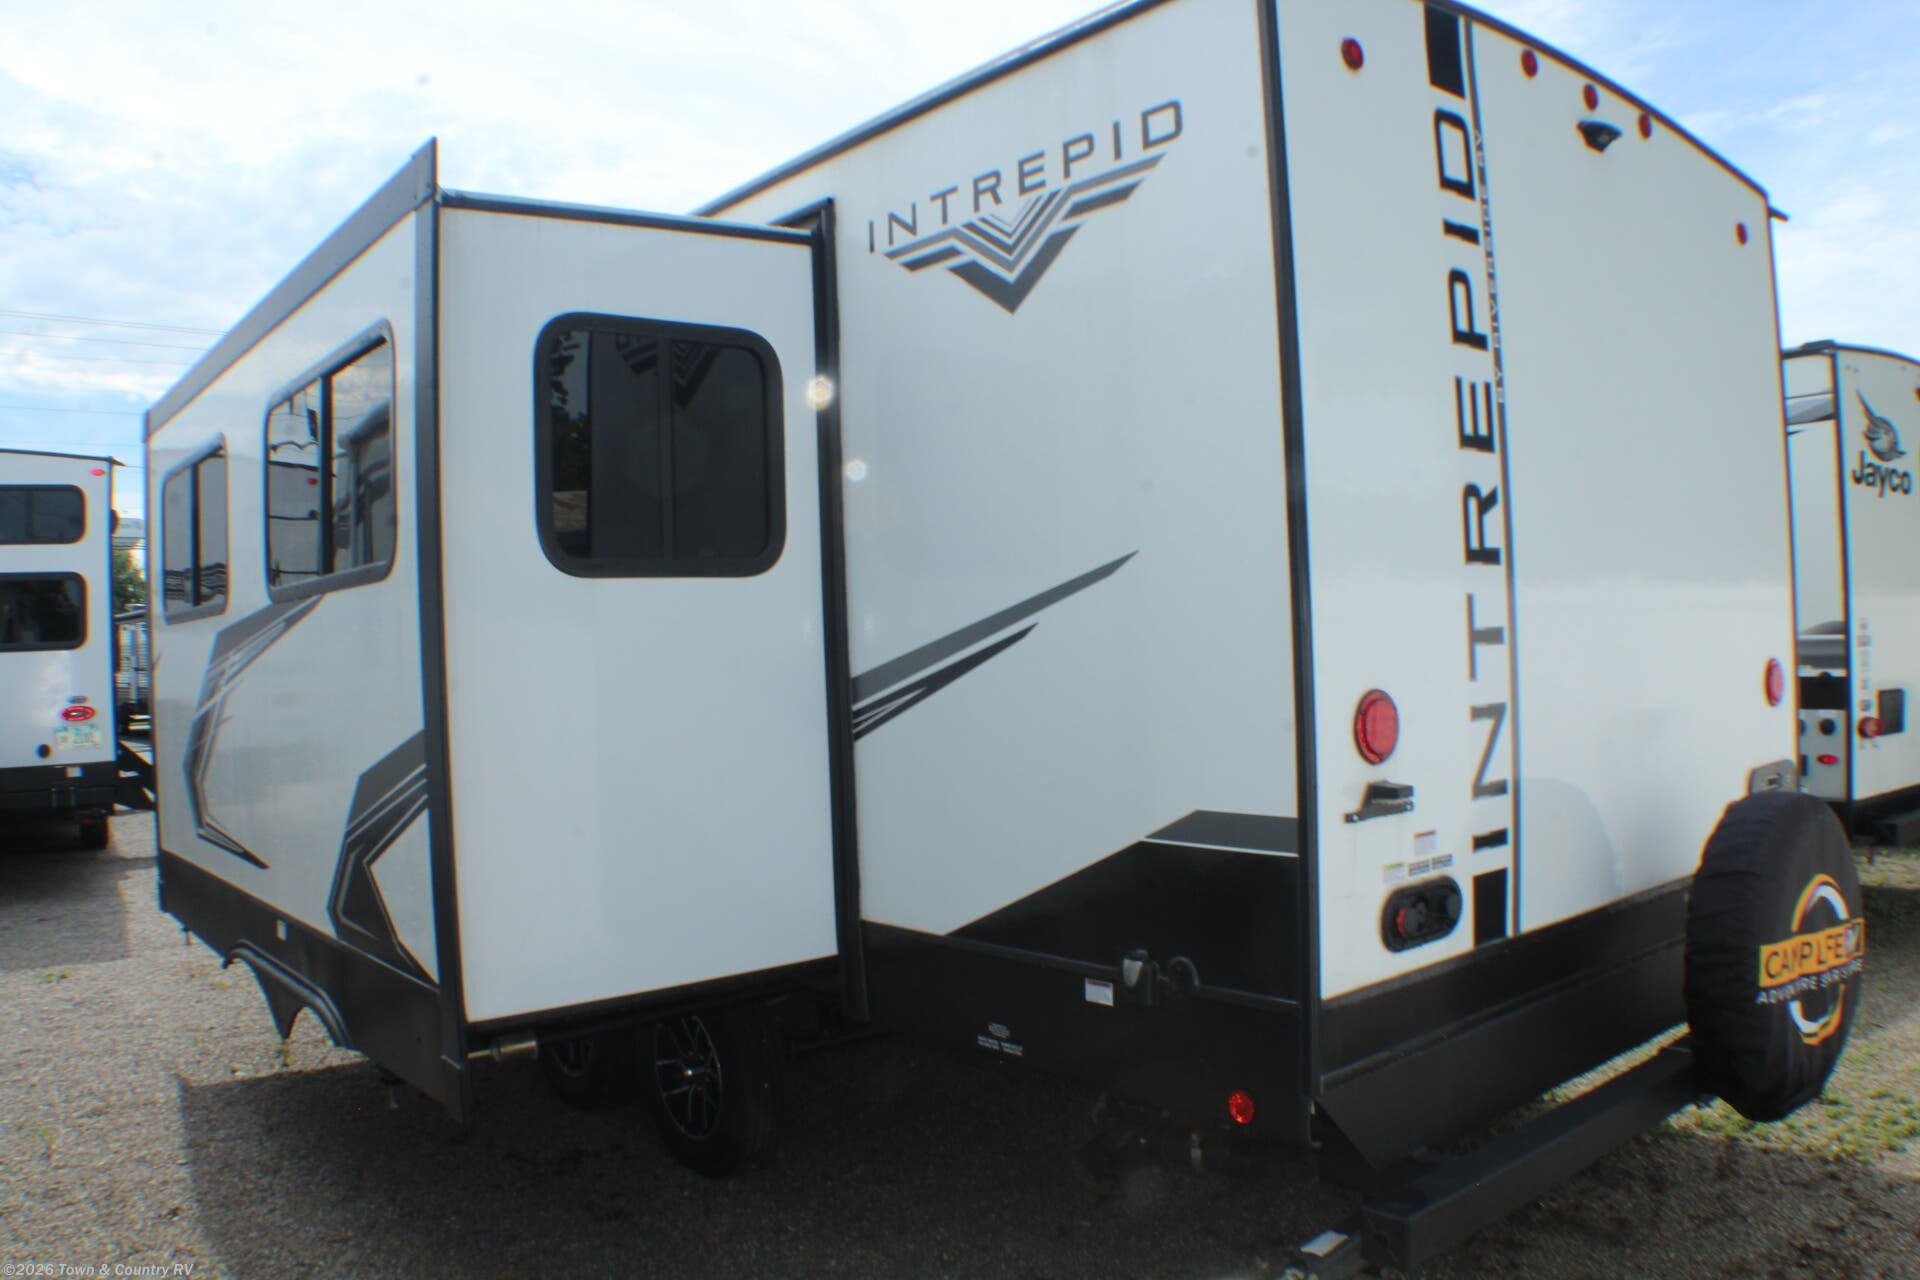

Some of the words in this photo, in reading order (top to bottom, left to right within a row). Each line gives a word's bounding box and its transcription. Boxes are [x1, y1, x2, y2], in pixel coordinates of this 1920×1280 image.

[868, 99, 1183, 254] INTREPID
[1434, 106, 1509, 853] INTREPID
[1850, 450, 1912, 499] Jayco
